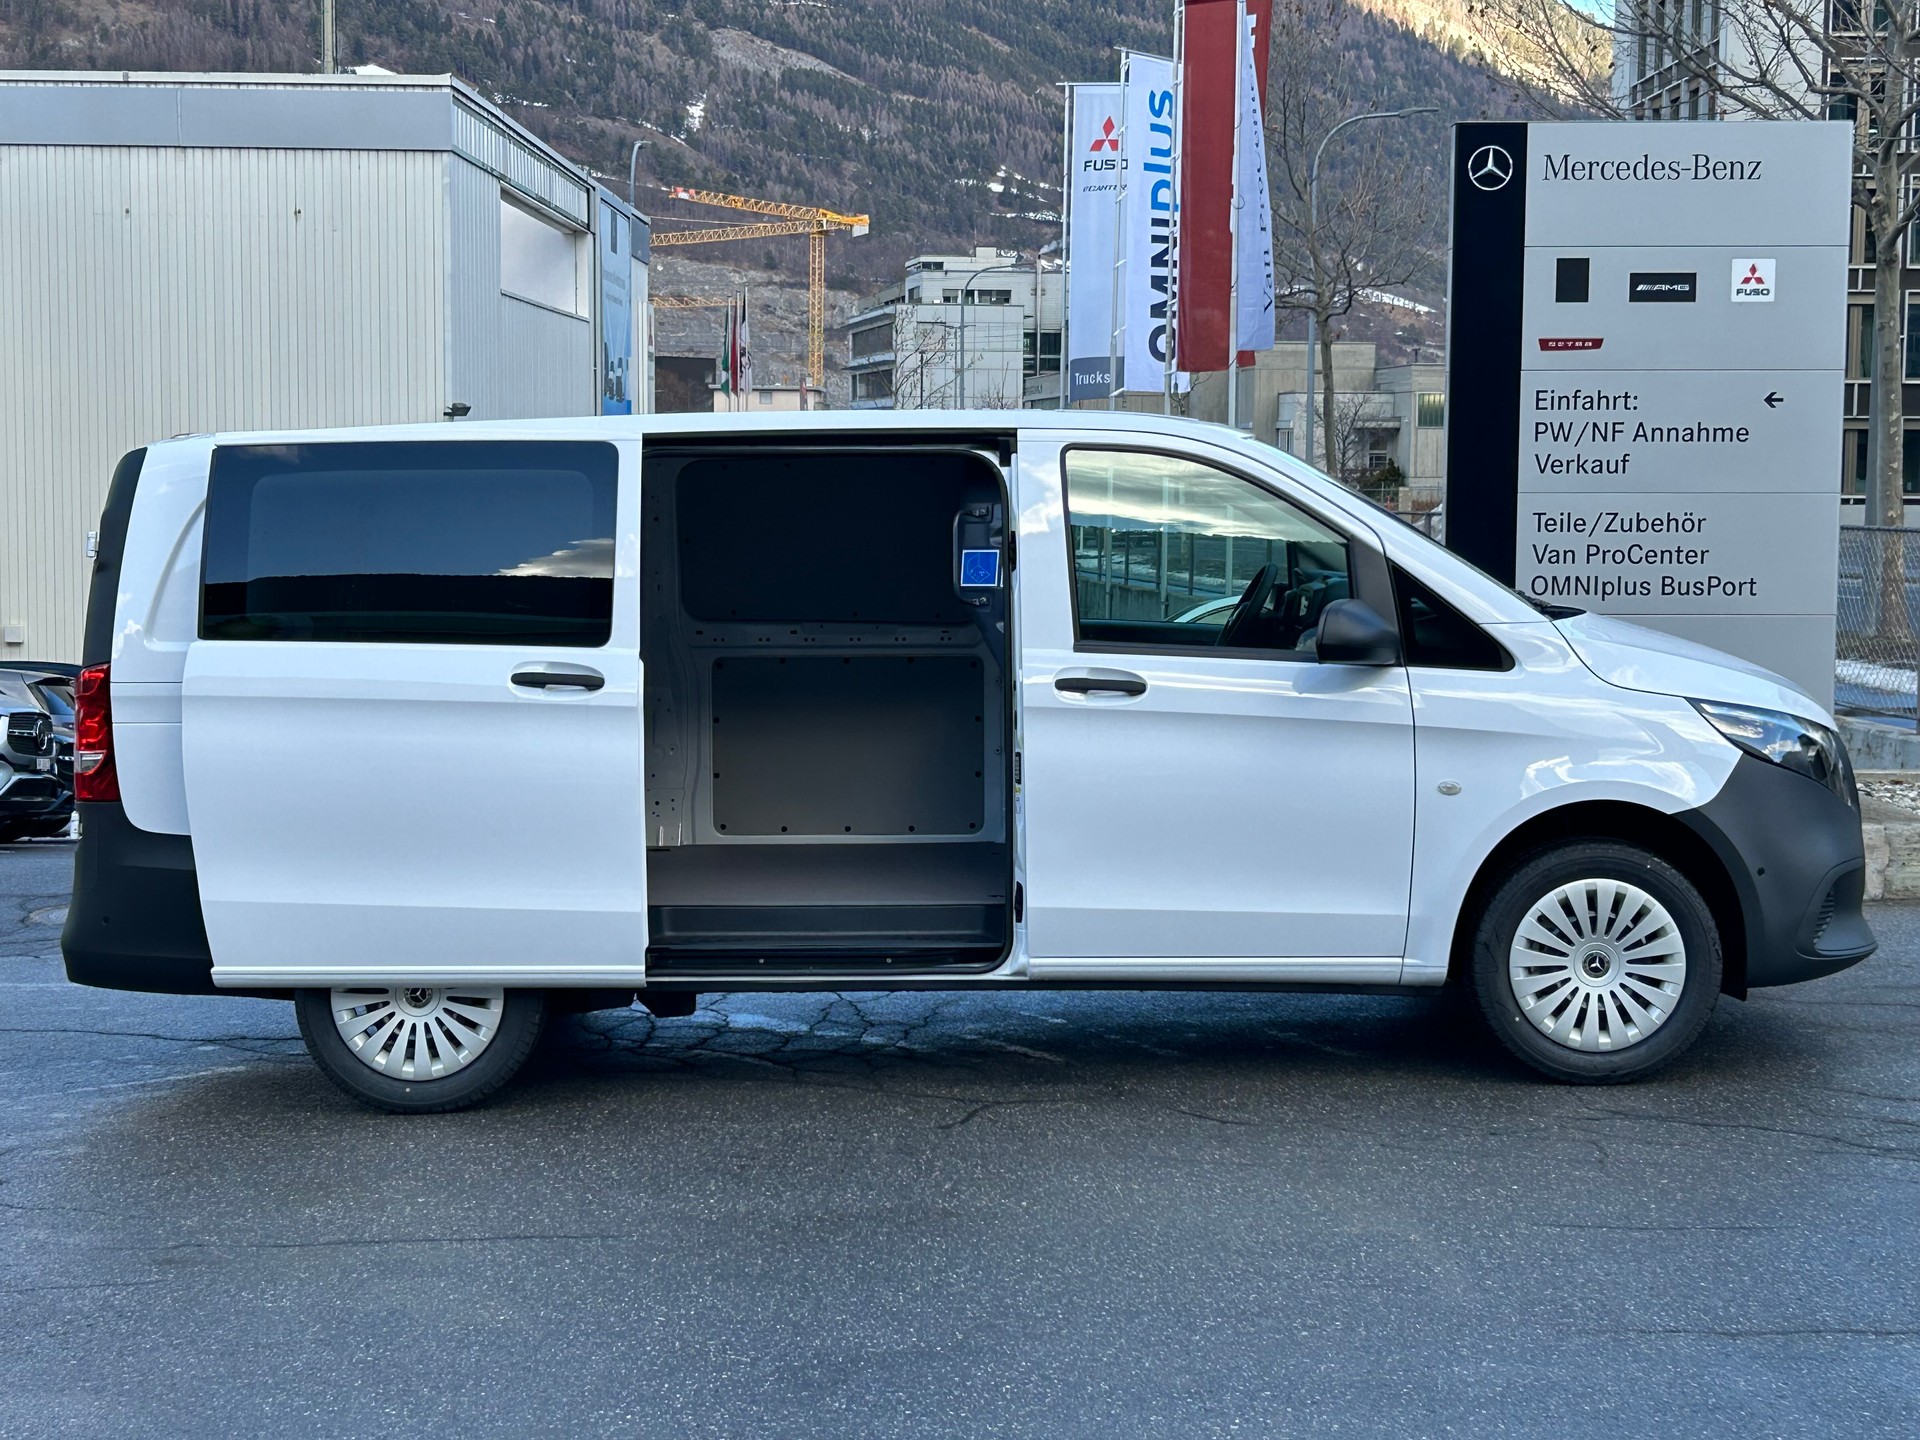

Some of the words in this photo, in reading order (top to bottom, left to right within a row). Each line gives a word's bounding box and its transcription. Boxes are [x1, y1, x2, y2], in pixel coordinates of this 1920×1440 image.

[1083, 157, 1129, 172] FUSO
[1542, 152, 1762, 182] Mercedes-Benz
[1651, 283, 1690, 291] AMG
[1735, 288, 1771, 297] FUSO
[1074, 369, 1111, 387] Trucks
[1535, 389, 1639, 411] Einfahrt:
[1534, 421, 1625, 447] PW/NF
[1632, 421, 1750, 443] Annahme
[1534, 453, 1631, 475] Verkauf
[1532, 511, 1707, 538] Teile/Zubehör
[1531, 543, 1576, 565] Van
[1586, 543, 1710, 565] ProCenter
[1531, 575, 1652, 602] OMNIplus
[1660, 575, 1758, 597] BusPort
